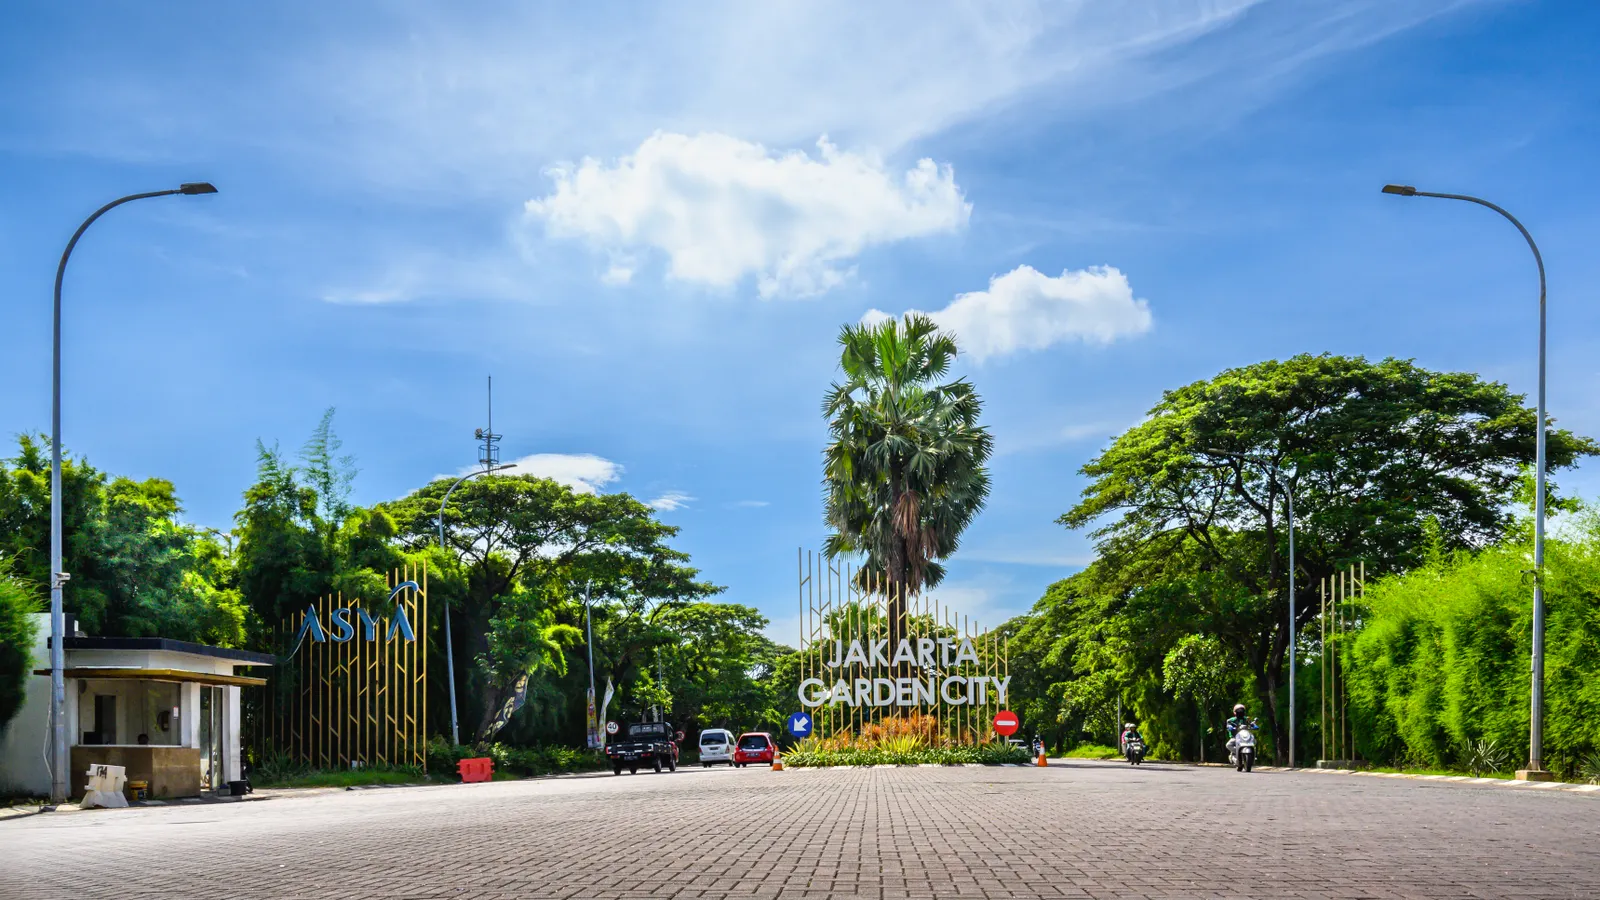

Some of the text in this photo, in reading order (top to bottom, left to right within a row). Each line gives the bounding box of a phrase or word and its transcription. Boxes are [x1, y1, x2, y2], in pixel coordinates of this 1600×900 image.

[286, 581, 419, 662] ASYA
[827, 637, 980, 668] JAKARTA
[797, 675, 1012, 707] GARDEN CITY
